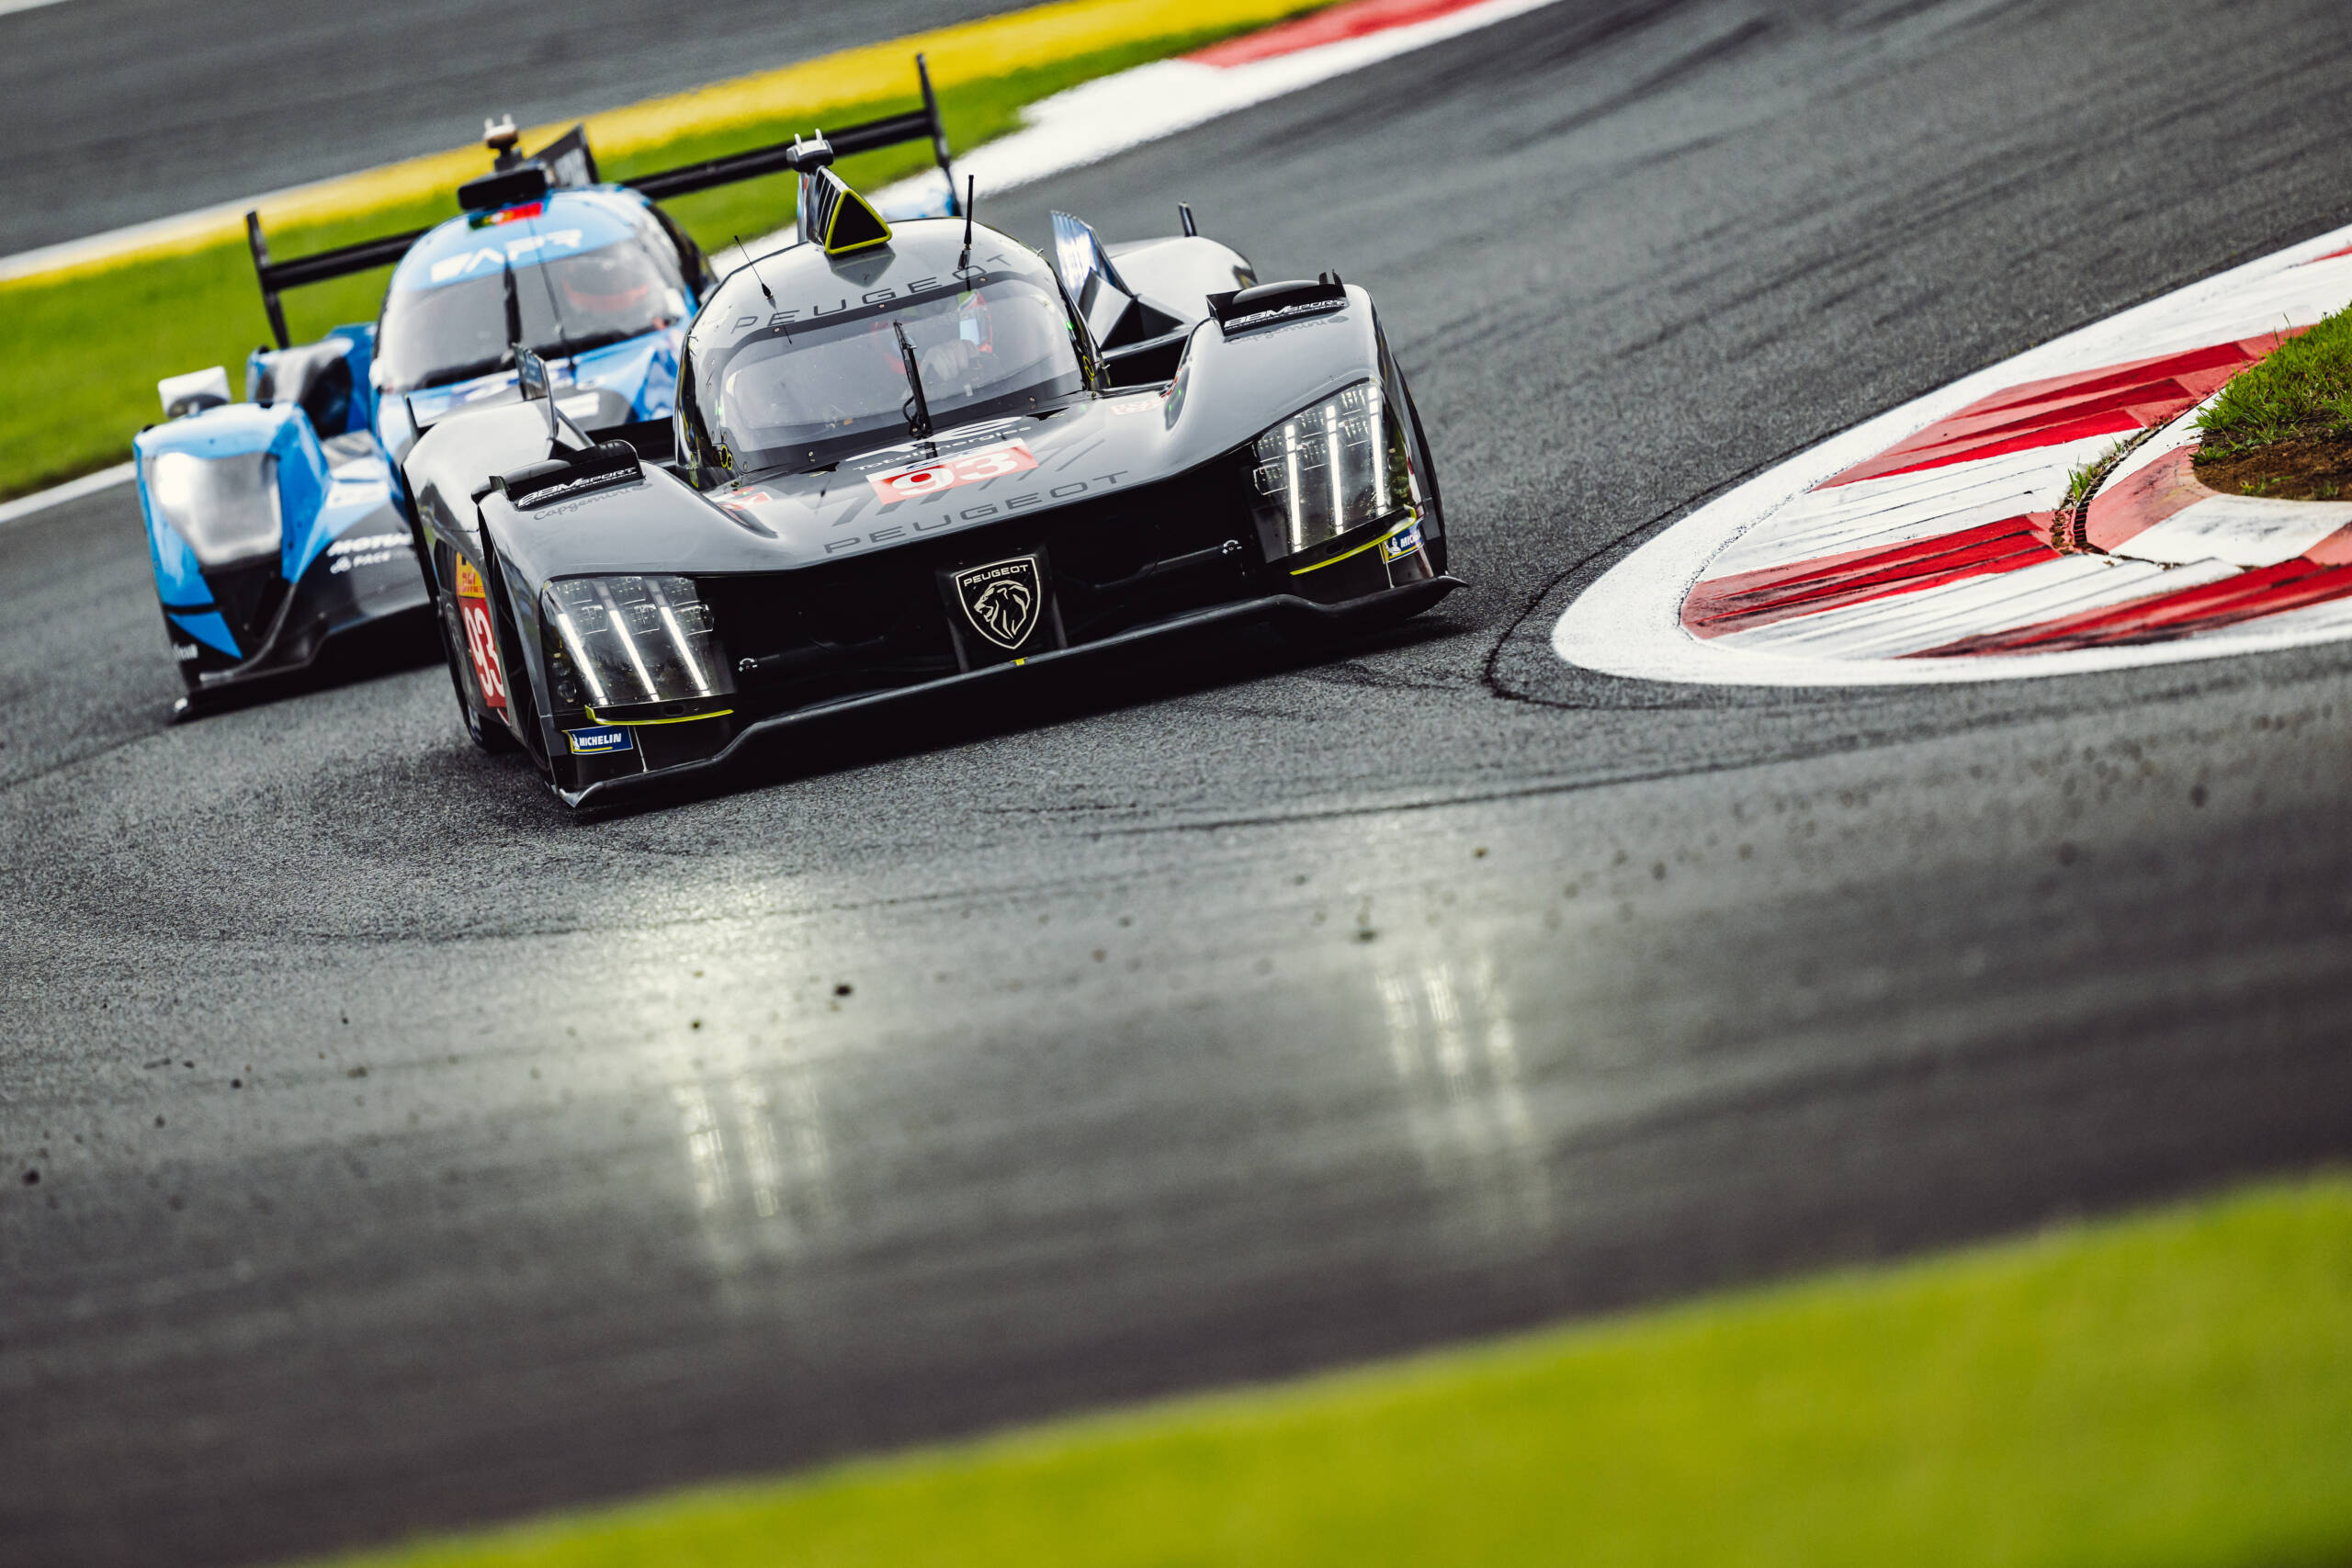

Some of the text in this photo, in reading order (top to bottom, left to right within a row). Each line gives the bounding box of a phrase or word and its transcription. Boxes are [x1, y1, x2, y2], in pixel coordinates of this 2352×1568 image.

[731, 254, 1012, 334] PEUGEOT
[891, 453, 1018, 496] 93
[533, 485, 632, 521] Capgemini
[823, 469, 1129, 555] PEUGEOT
[963, 564, 1029, 587] PEUGEOT
[464, 606, 505, 698] 93
[579, 733, 622, 747] MICHELIN
